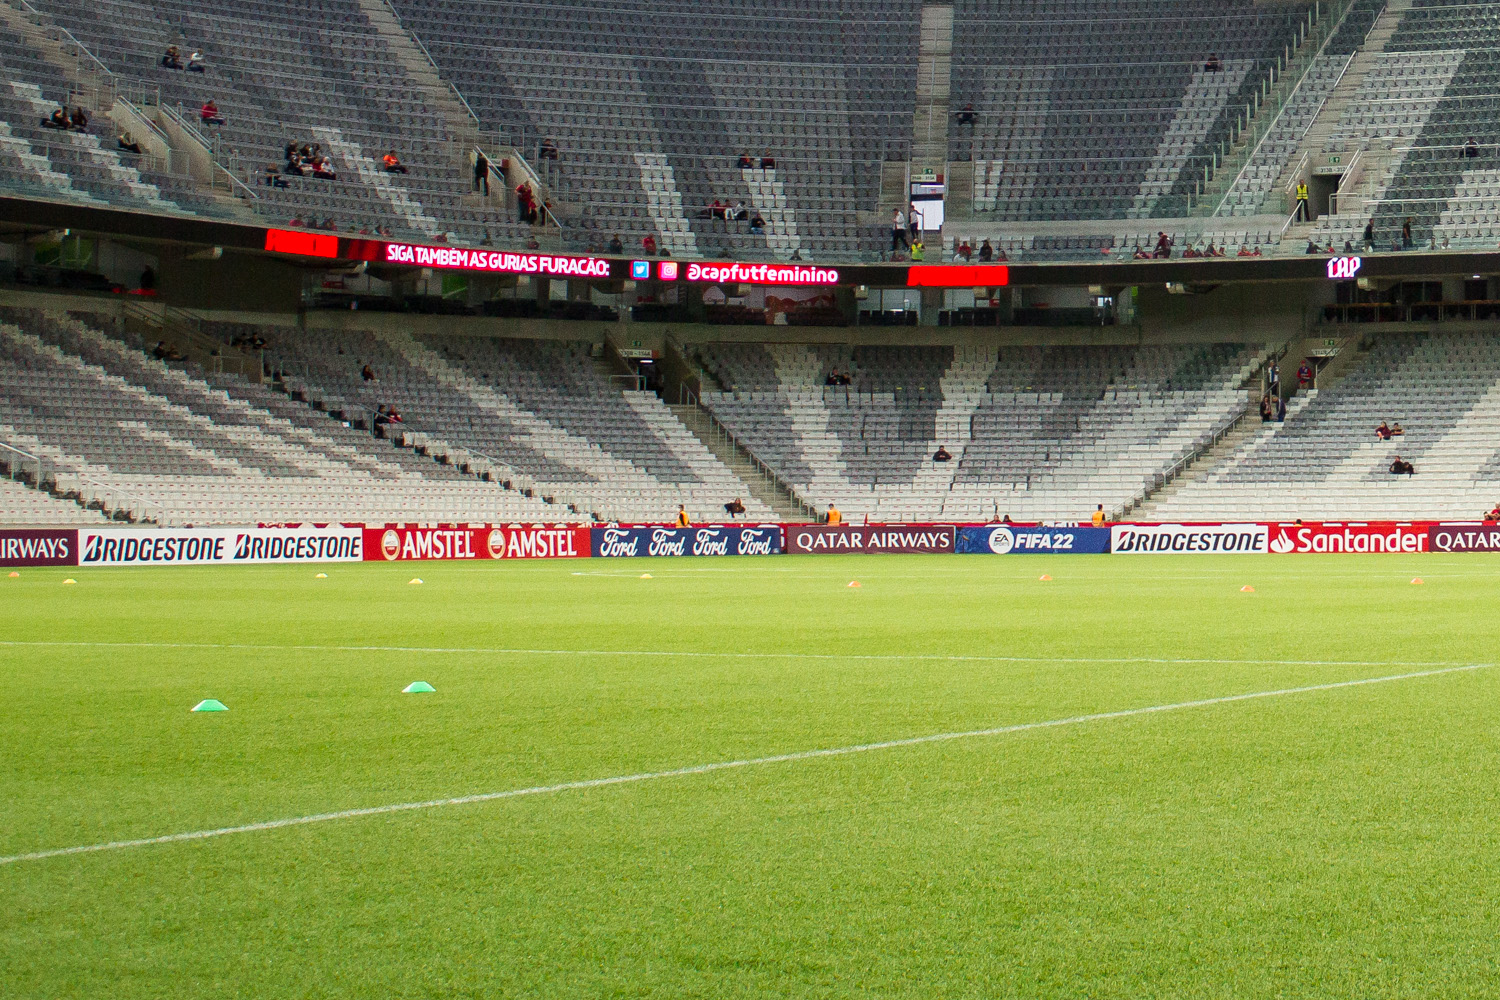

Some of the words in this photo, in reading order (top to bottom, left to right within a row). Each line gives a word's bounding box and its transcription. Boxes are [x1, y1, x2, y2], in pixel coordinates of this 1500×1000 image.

[387, 244, 414, 263] SIGA
[415, 247, 468, 267] TAMBÉM
[469, 251, 487, 268] AS
[488, 252, 538, 272] GURIAS
[539, 256, 610, 276] FURACÃO:
[687, 263, 838, 284] @capfutfeminino
[0, 538, 69, 558] IRWAYS
[83, 535, 225, 562] BRIDGESTONE
[233, 534, 361, 559] BRIDGESTONE
[402, 530, 475, 559] AMSTEL
[507, 530, 577, 558] AMSTEL
[600, 529, 638, 556] Ford
[649, 529, 685, 556] Ford
[693, 529, 728, 555] Ford
[738, 529, 771, 554] Ford
[796, 531, 862, 551] QATAR
[867, 531, 950, 549] AIRWAYS
[1115, 531, 1264, 551] BRIDGESTONE
[1297, 528, 1427, 552] Santander
